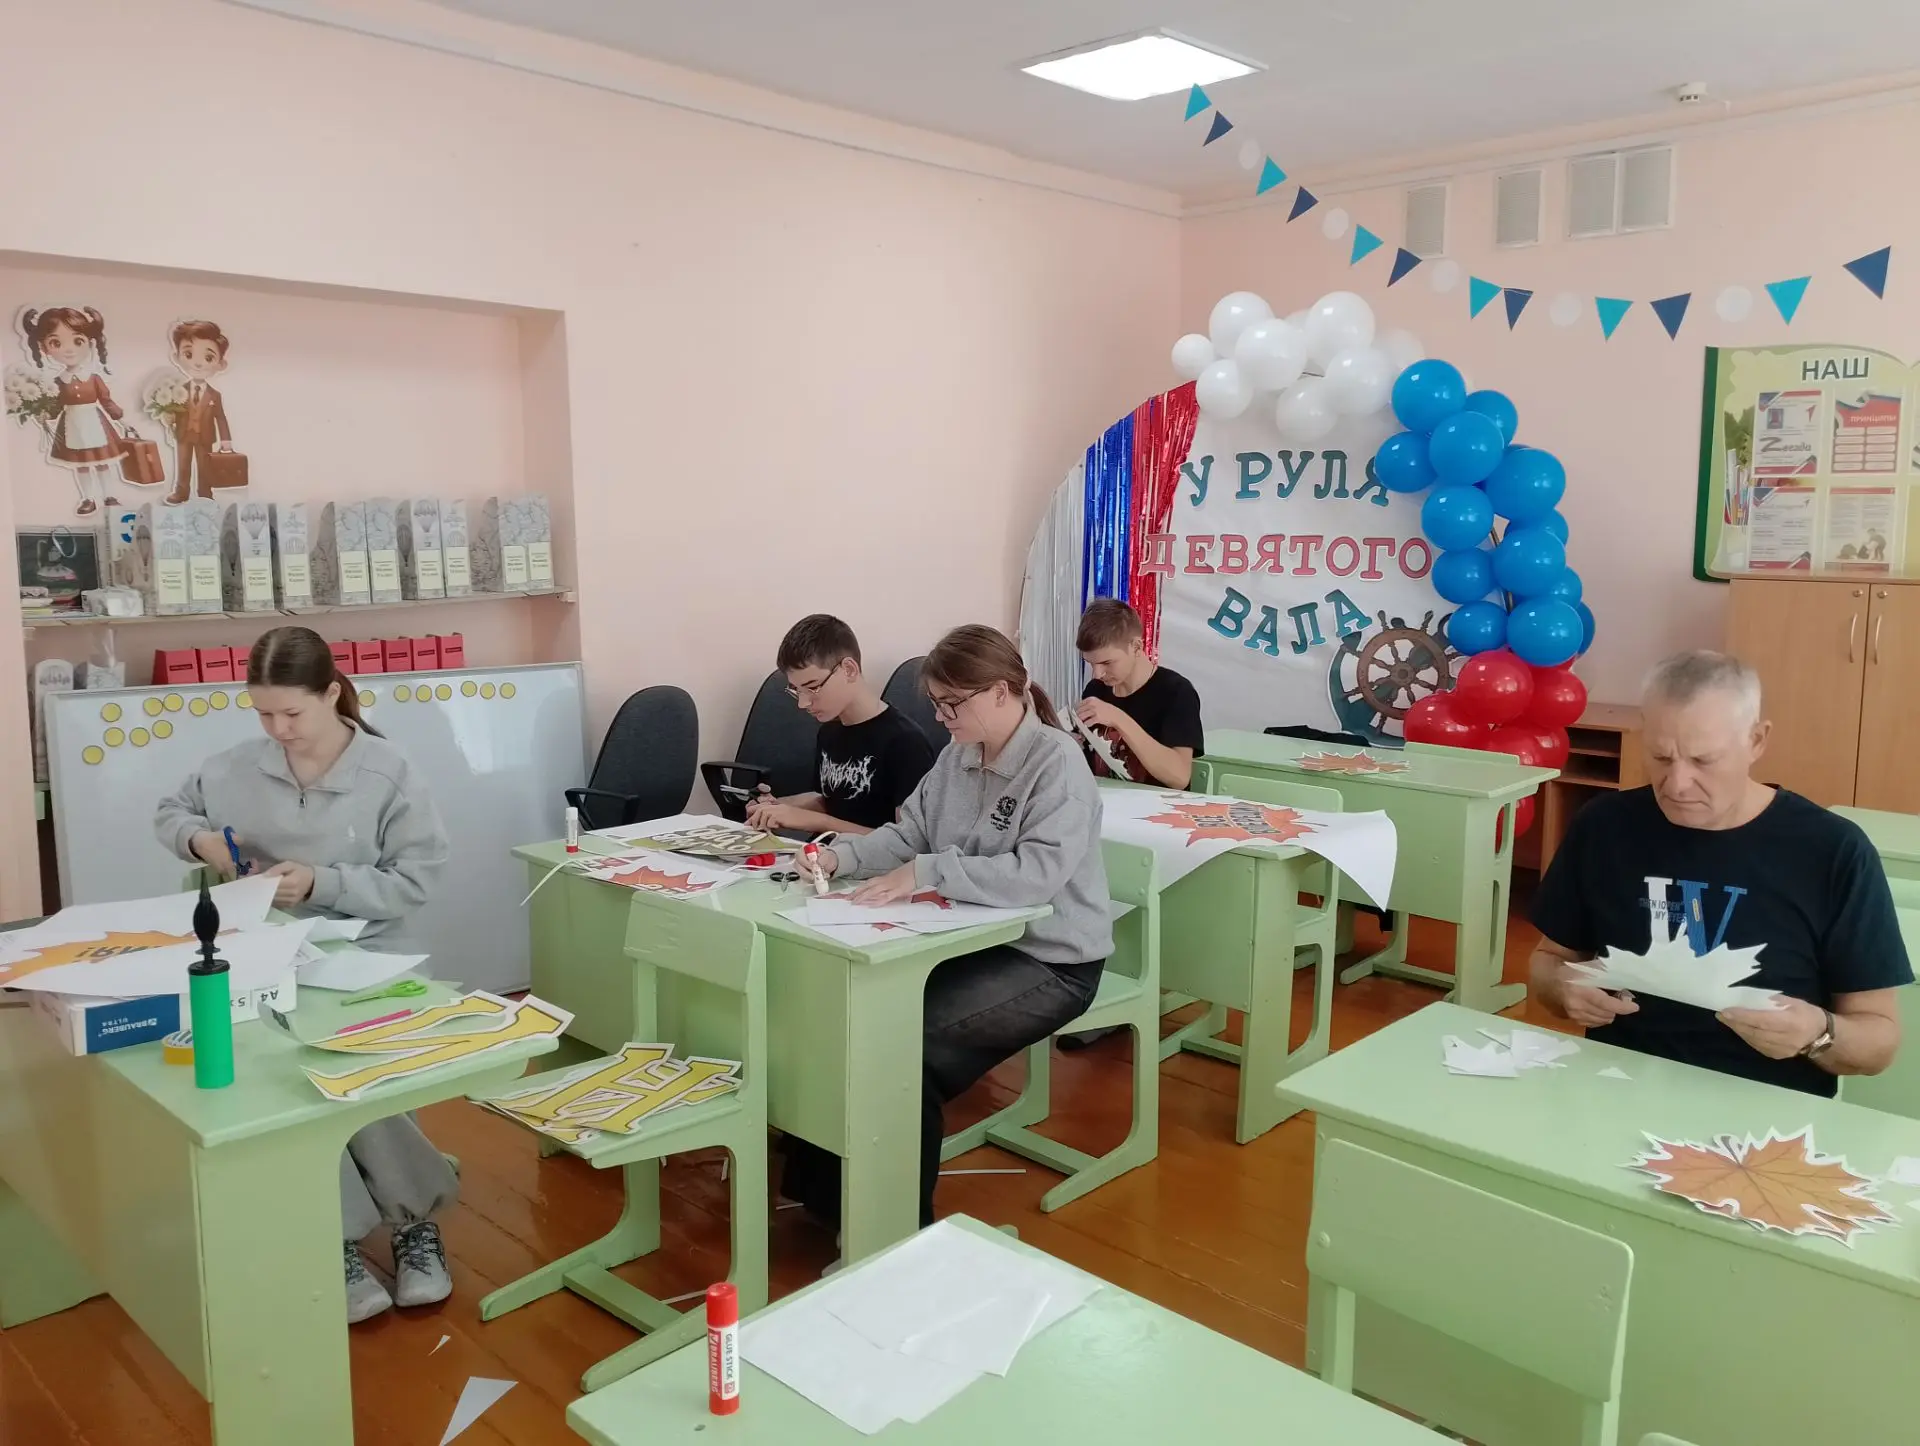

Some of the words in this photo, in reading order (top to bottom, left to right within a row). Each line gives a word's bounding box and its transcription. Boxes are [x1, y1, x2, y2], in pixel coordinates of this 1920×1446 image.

[1801, 357, 1870, 381] НАШ
[1179, 454, 1215, 507] У
[1234, 449, 1390, 508] РУЛЯ
[1138, 533, 1433, 580] ДЕВЯТОГО
[1206, 585, 1373, 657] ВАЛА
[259, 989, 280, 1003] A4
[102, 1018, 147, 1037] BRAUBERG
[710, 1344, 719, 1392] BRAUBERG
